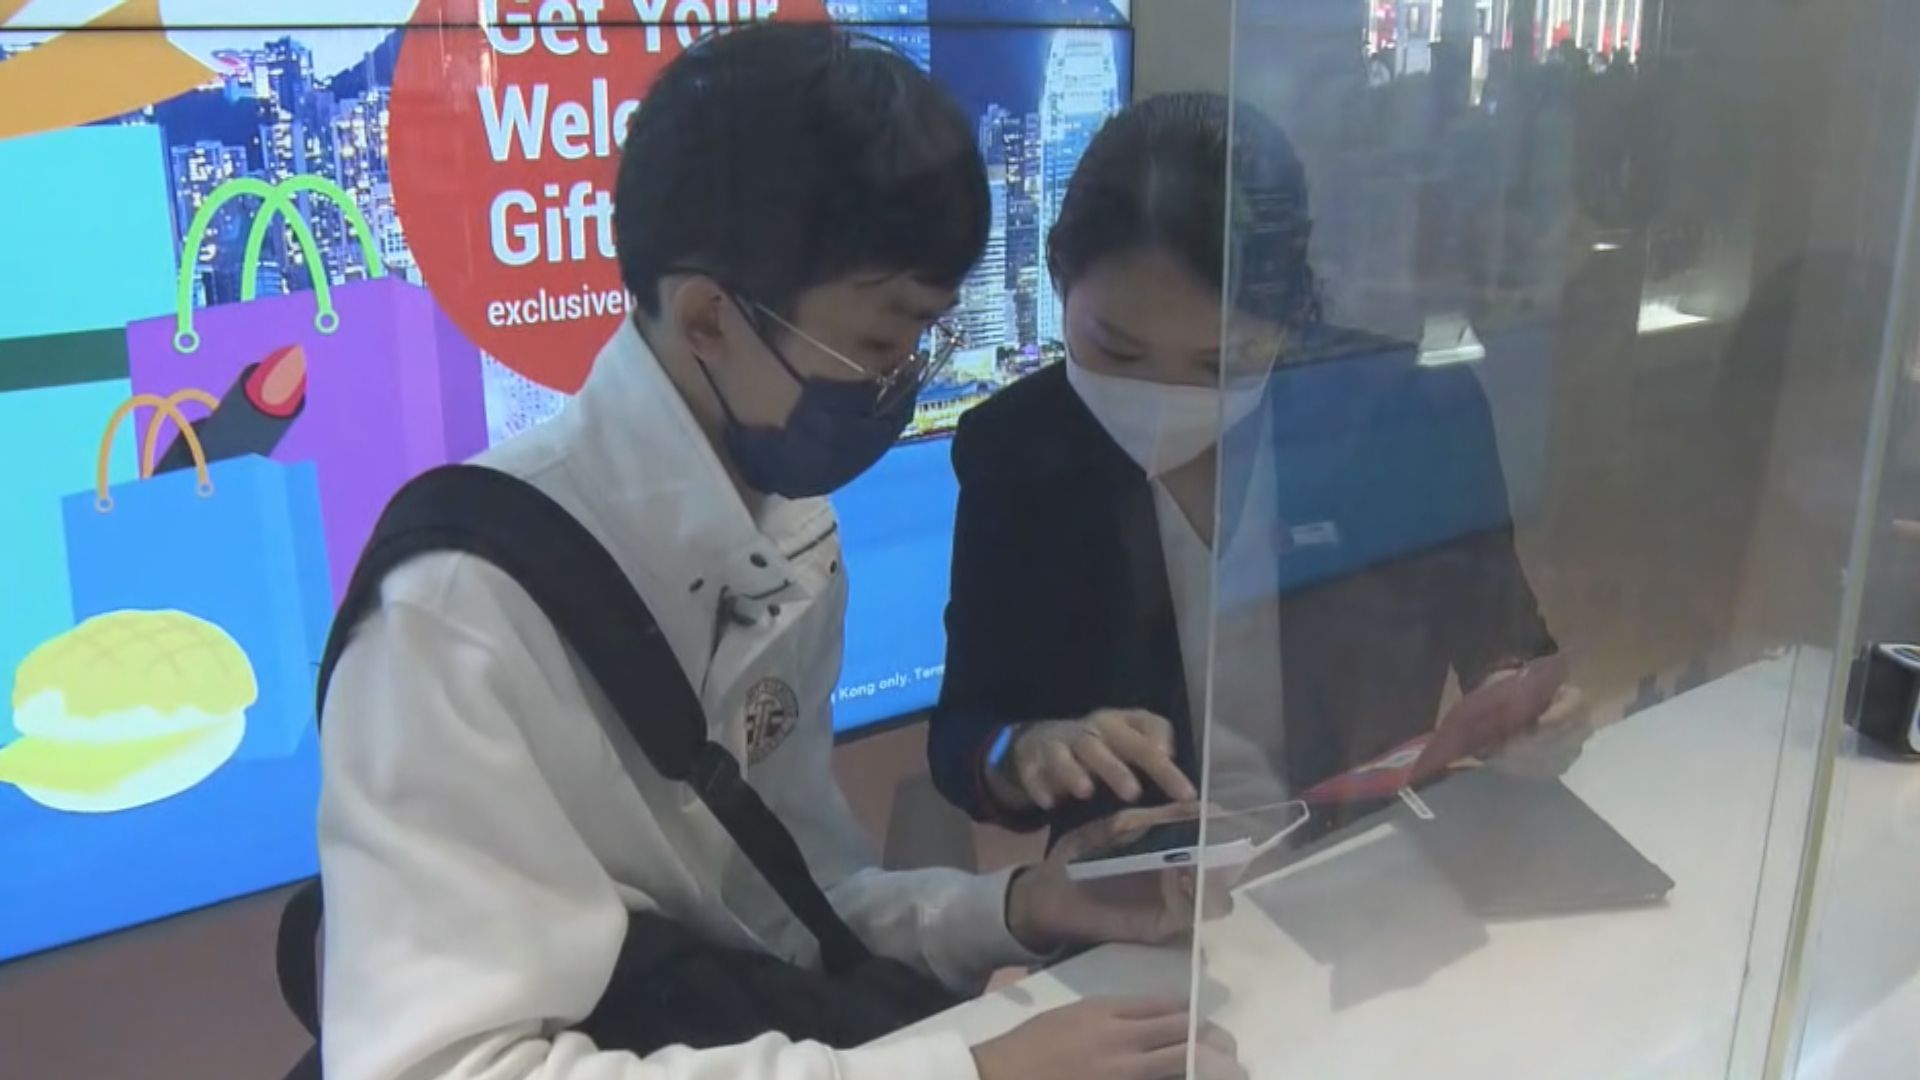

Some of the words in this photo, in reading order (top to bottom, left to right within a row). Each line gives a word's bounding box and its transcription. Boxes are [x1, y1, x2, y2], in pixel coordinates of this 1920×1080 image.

[486, 0, 609, 55] Get
[476, 78, 639, 162] Welc
[487, 284, 637, 327] exclusivel
[838, 683, 876, 701] Kong
[879, 672, 912, 688] only.
